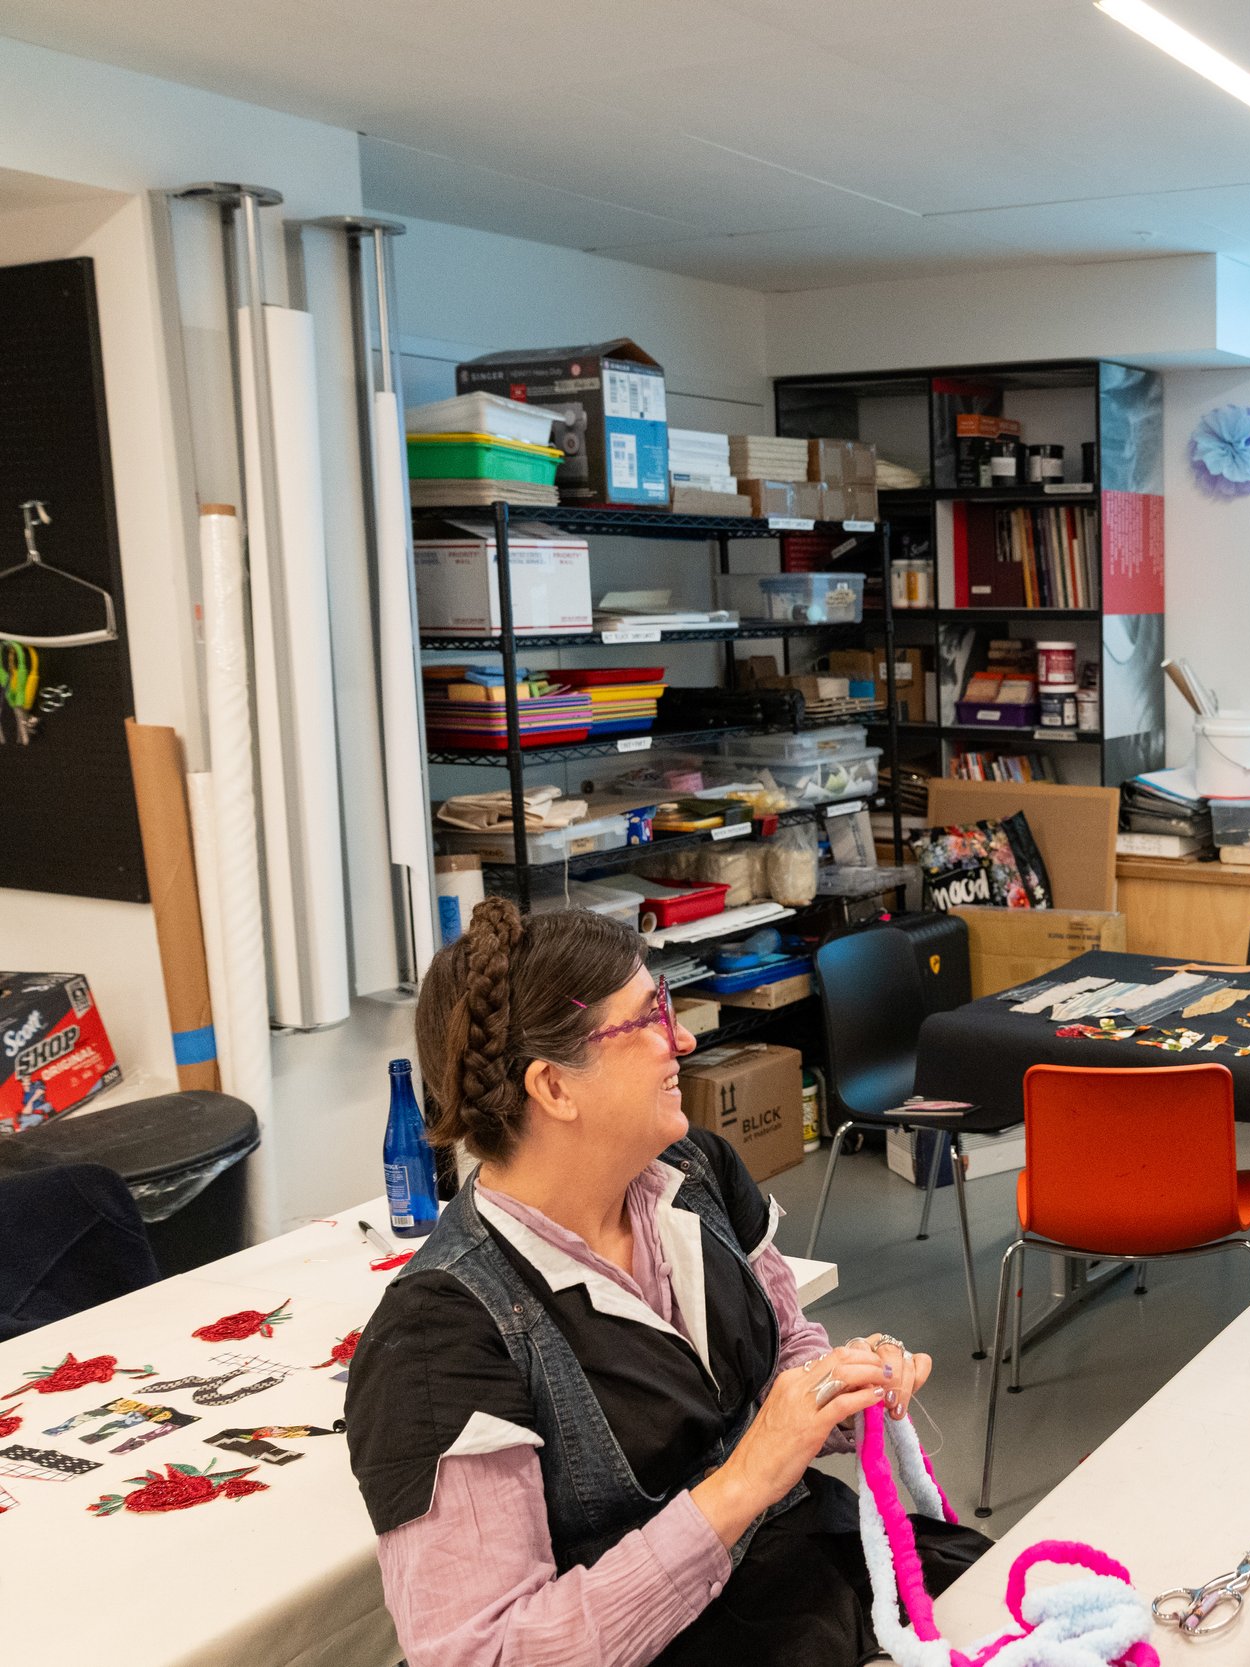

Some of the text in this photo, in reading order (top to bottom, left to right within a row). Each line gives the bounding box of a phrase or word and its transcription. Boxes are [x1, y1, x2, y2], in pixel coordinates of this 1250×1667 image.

[930, 868, 990, 911] mood
[3, 1009, 43, 1058] Scott
[17, 1026, 78, 1076] SHOP
[742, 1106, 782, 1134] BLICK
